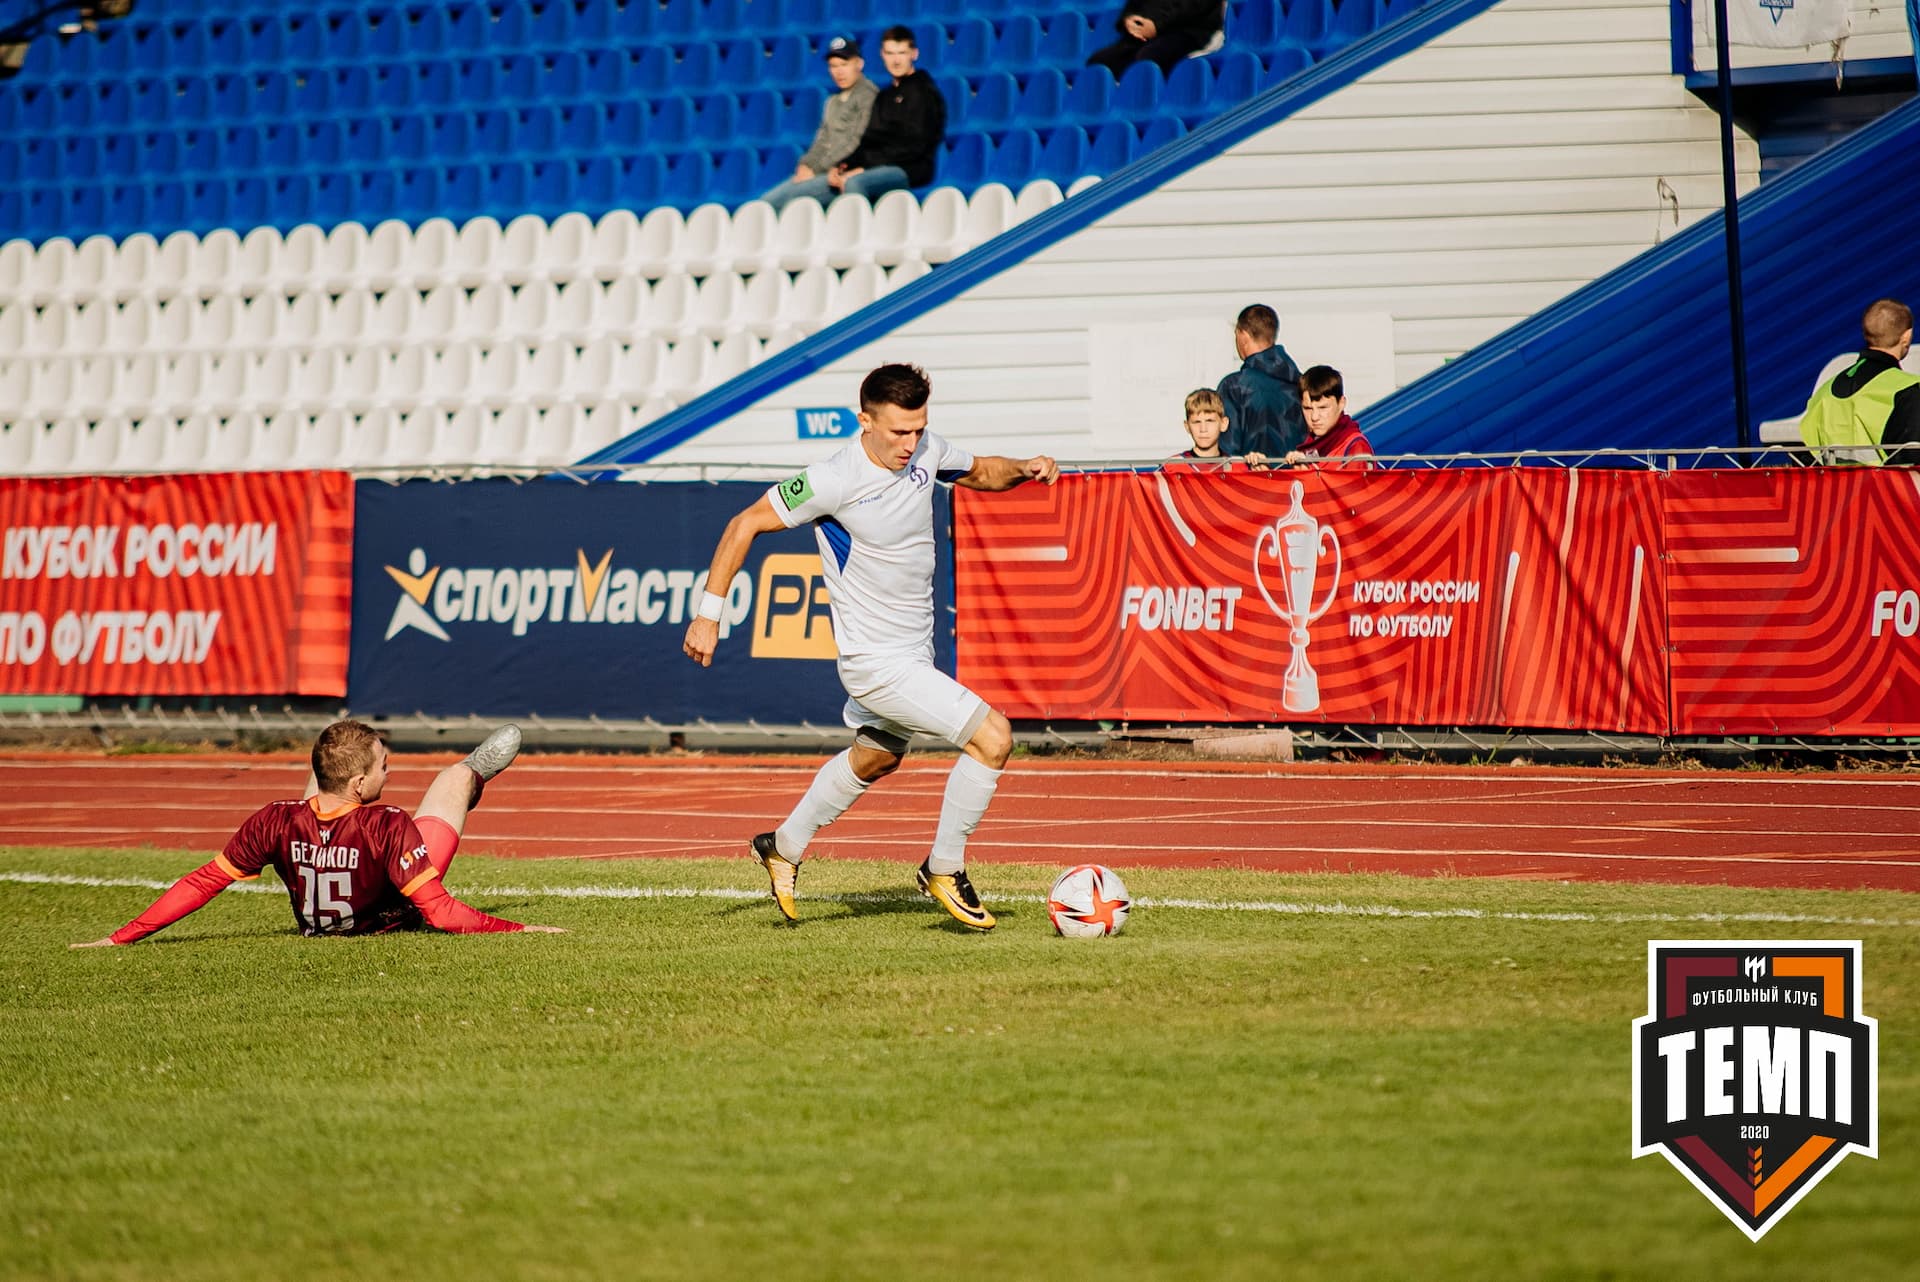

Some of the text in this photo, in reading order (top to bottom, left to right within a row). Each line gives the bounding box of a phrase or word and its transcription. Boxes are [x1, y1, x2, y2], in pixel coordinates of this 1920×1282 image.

[806, 411, 842, 436] WC
[2, 522, 278, 579] КУБОК РОССИИ
[1120, 585, 1242, 631] FONBET
[1353, 580, 1480, 604] КУБОК РОССИИ
[1871, 589, 1920, 637] FO
[0, 609, 222, 666] ПО ФУТБОЛУ
[1349, 615, 1453, 638] ПО ФУТБОЛУ
[290, 840, 360, 870] БЕЛИКОВ
[298, 865, 355, 933] 15
